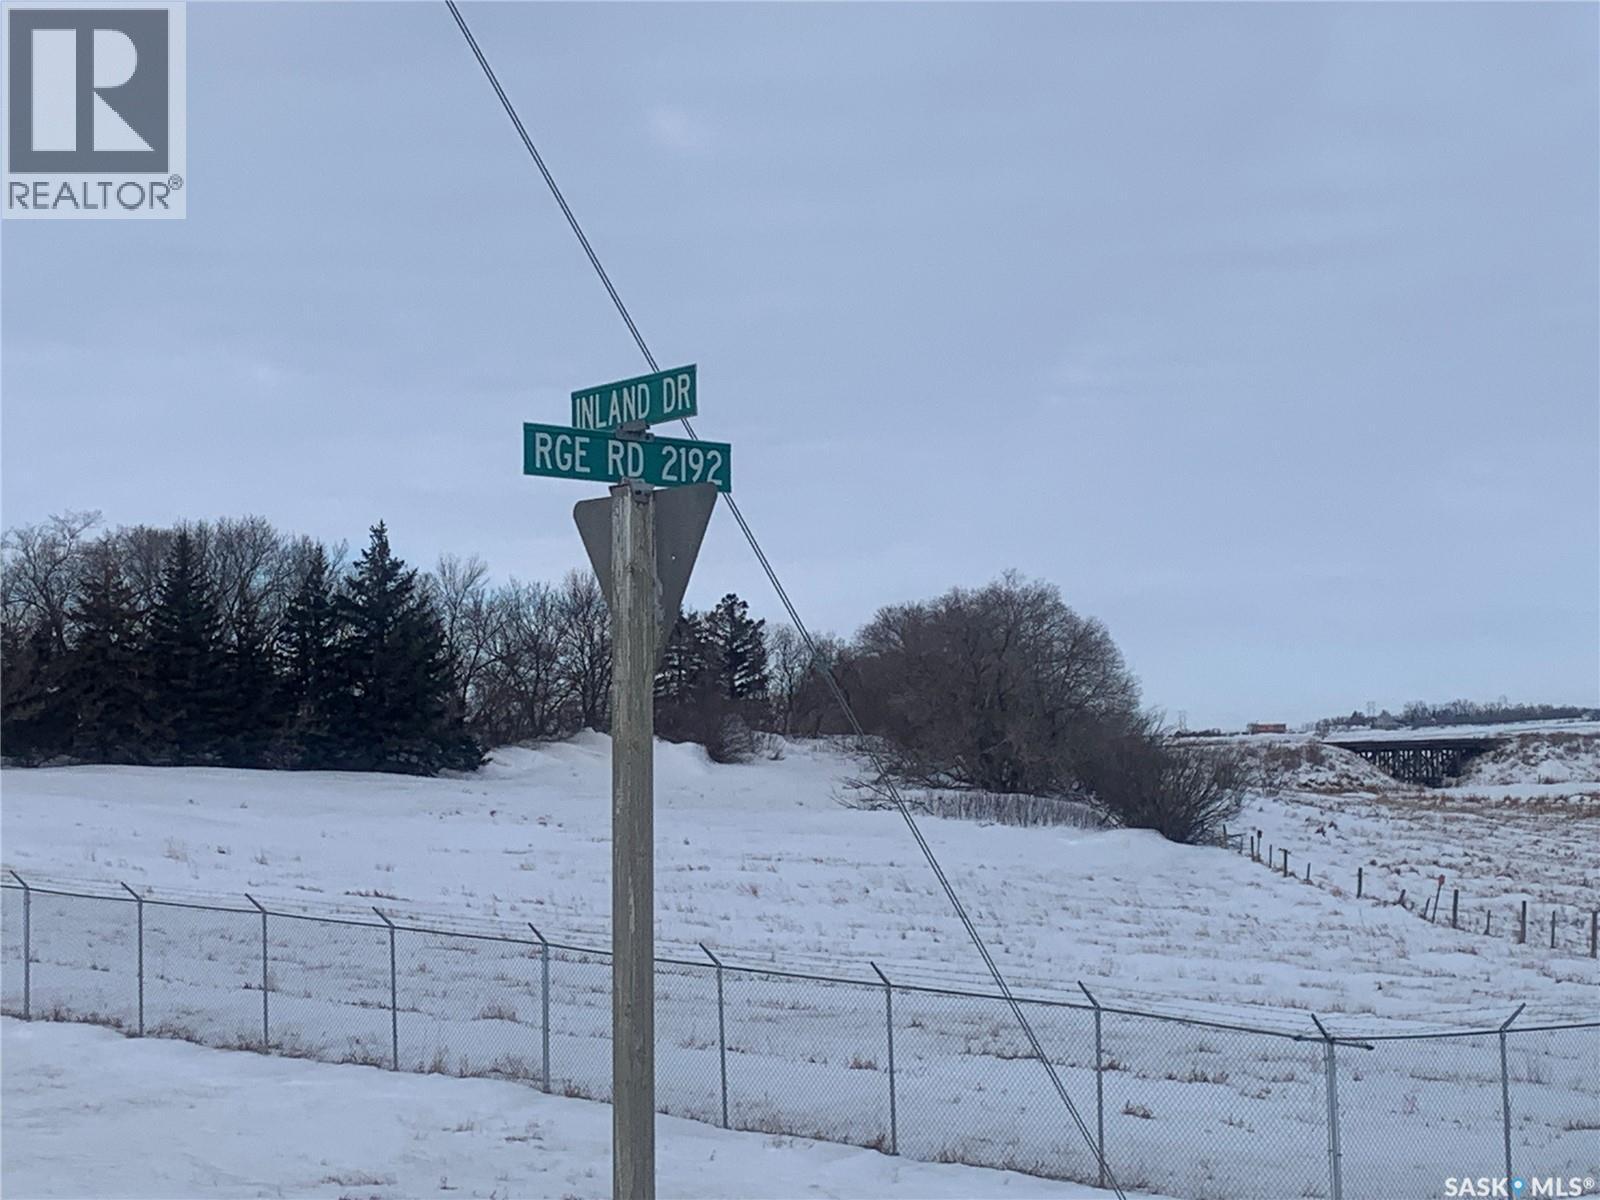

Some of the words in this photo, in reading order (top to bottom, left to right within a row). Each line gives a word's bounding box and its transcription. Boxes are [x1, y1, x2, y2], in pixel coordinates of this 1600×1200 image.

[576, 383, 649, 429] INLAND
[663, 373, 691, 414] DR
[535, 432, 590, 473] RGE
[608, 439, 644, 477] RD
[661, 445, 722, 486] 2192
